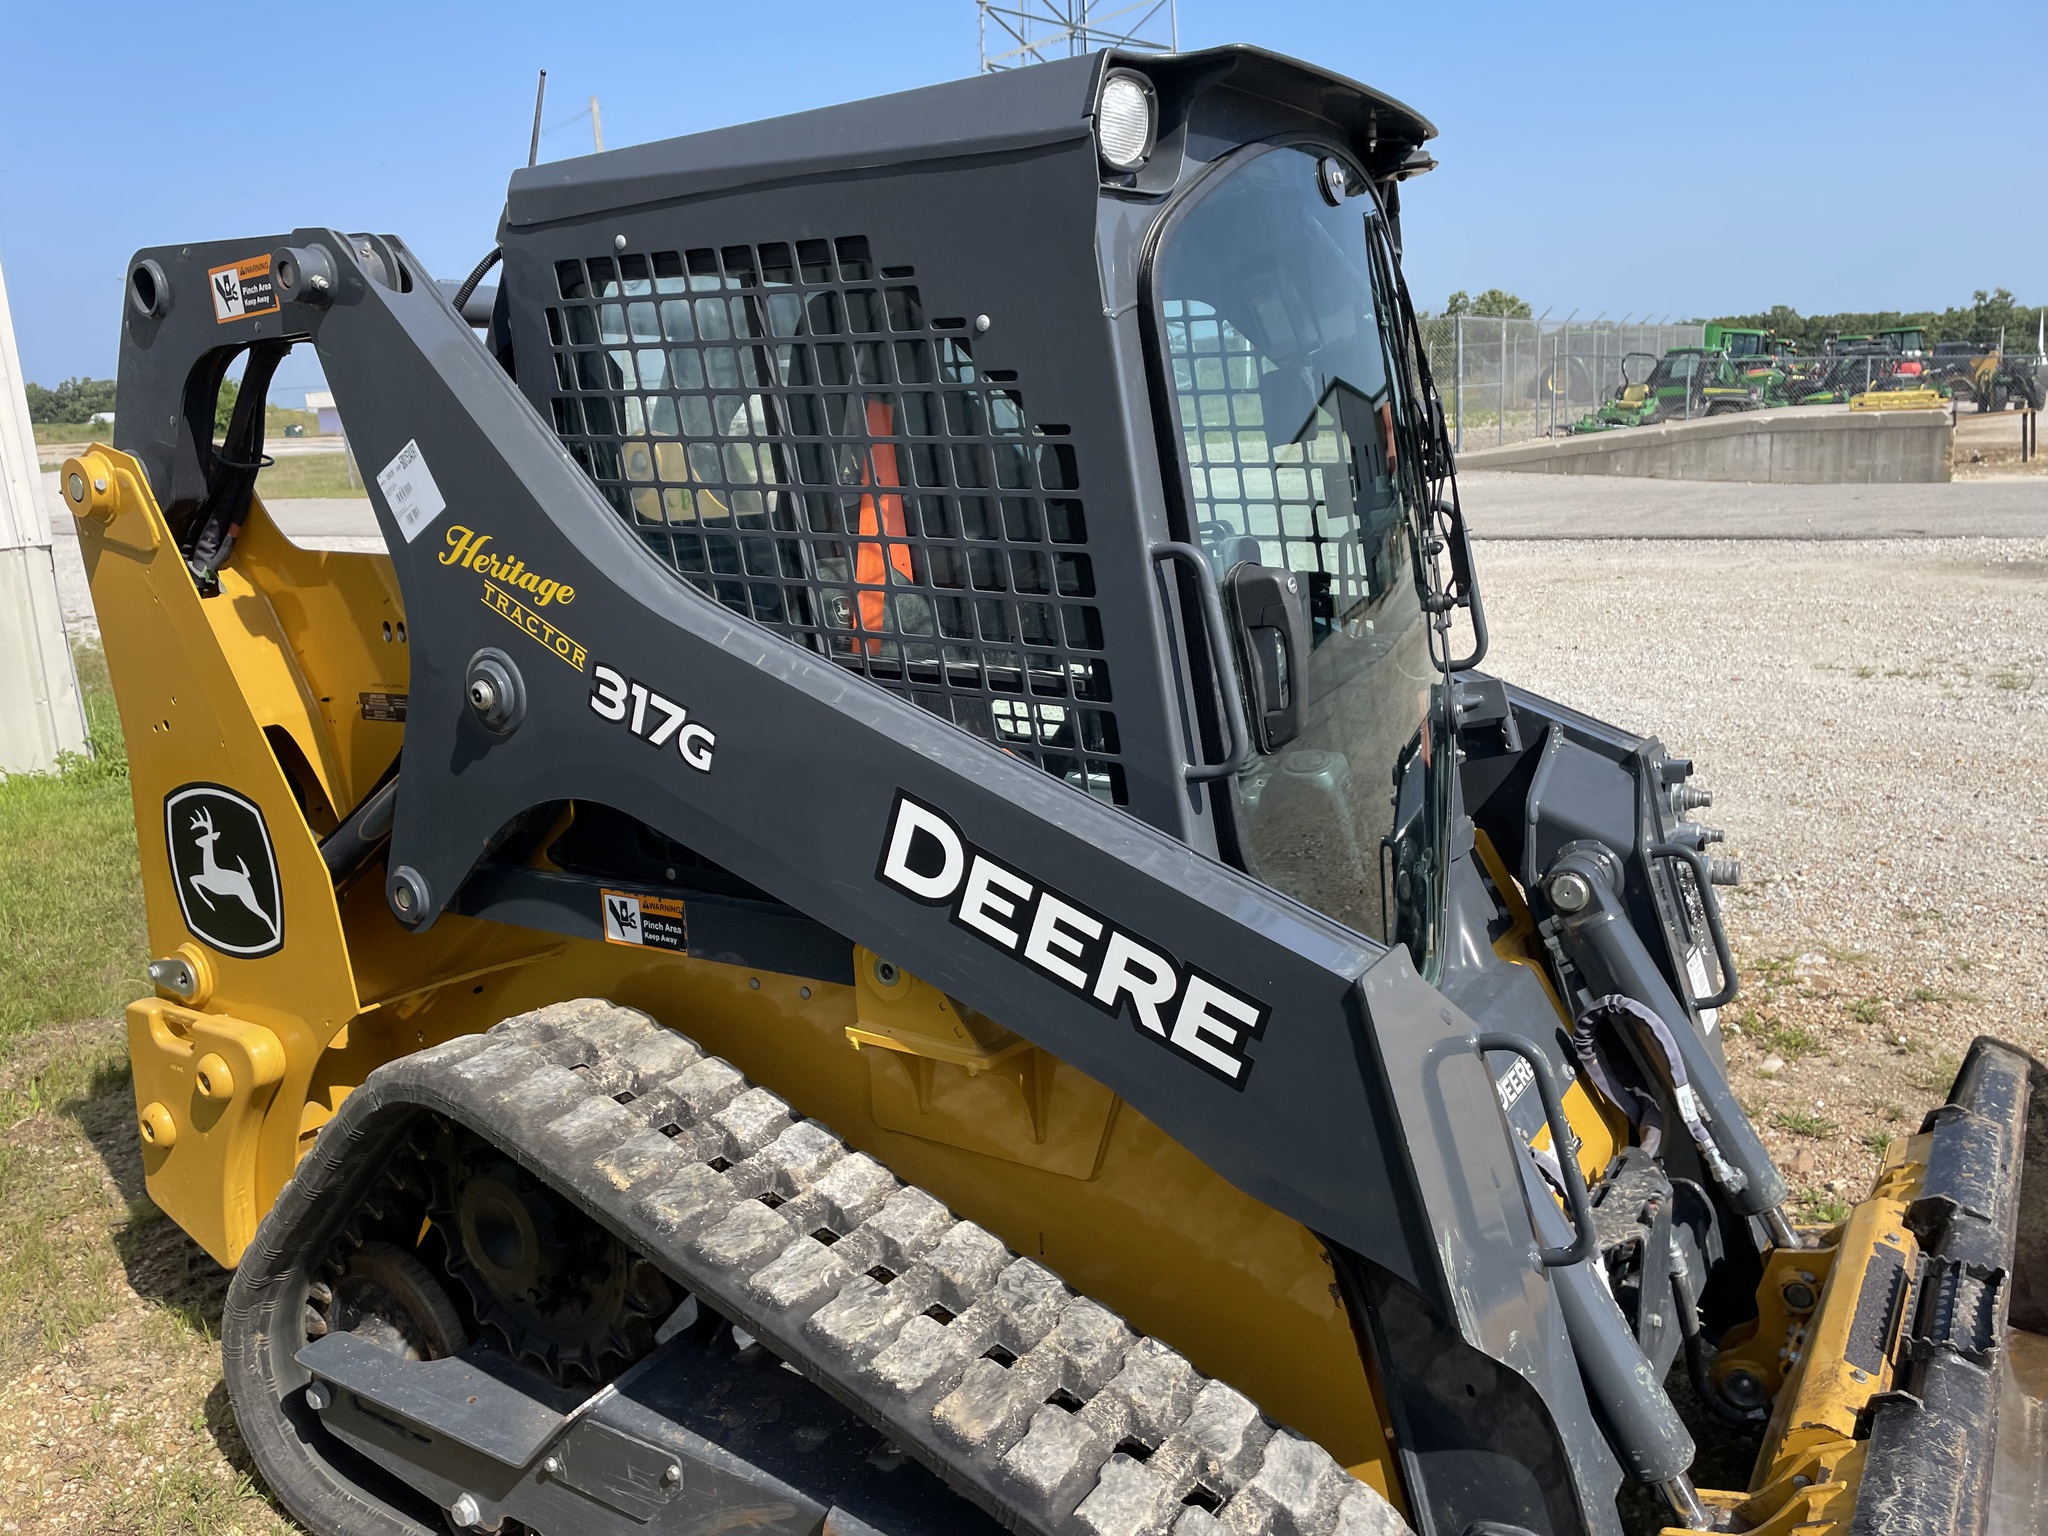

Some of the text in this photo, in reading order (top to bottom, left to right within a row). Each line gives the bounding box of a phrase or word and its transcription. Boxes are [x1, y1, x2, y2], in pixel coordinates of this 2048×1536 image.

[245, 262, 269, 274] WARNING
[242, 282, 272, 295] Pinch Area
[244, 295, 270, 307] Keep Away
[438, 524, 576, 607] Heritage
[482, 584, 588, 669] TRACTOR
[591, 664, 716, 772] 317G
[649, 902, 681, 914] WARNING
[643, 919, 682, 935] Pinch Area
[644, 931, 678, 946] Keep Away
[883, 798, 1260, 1079] DEERE
